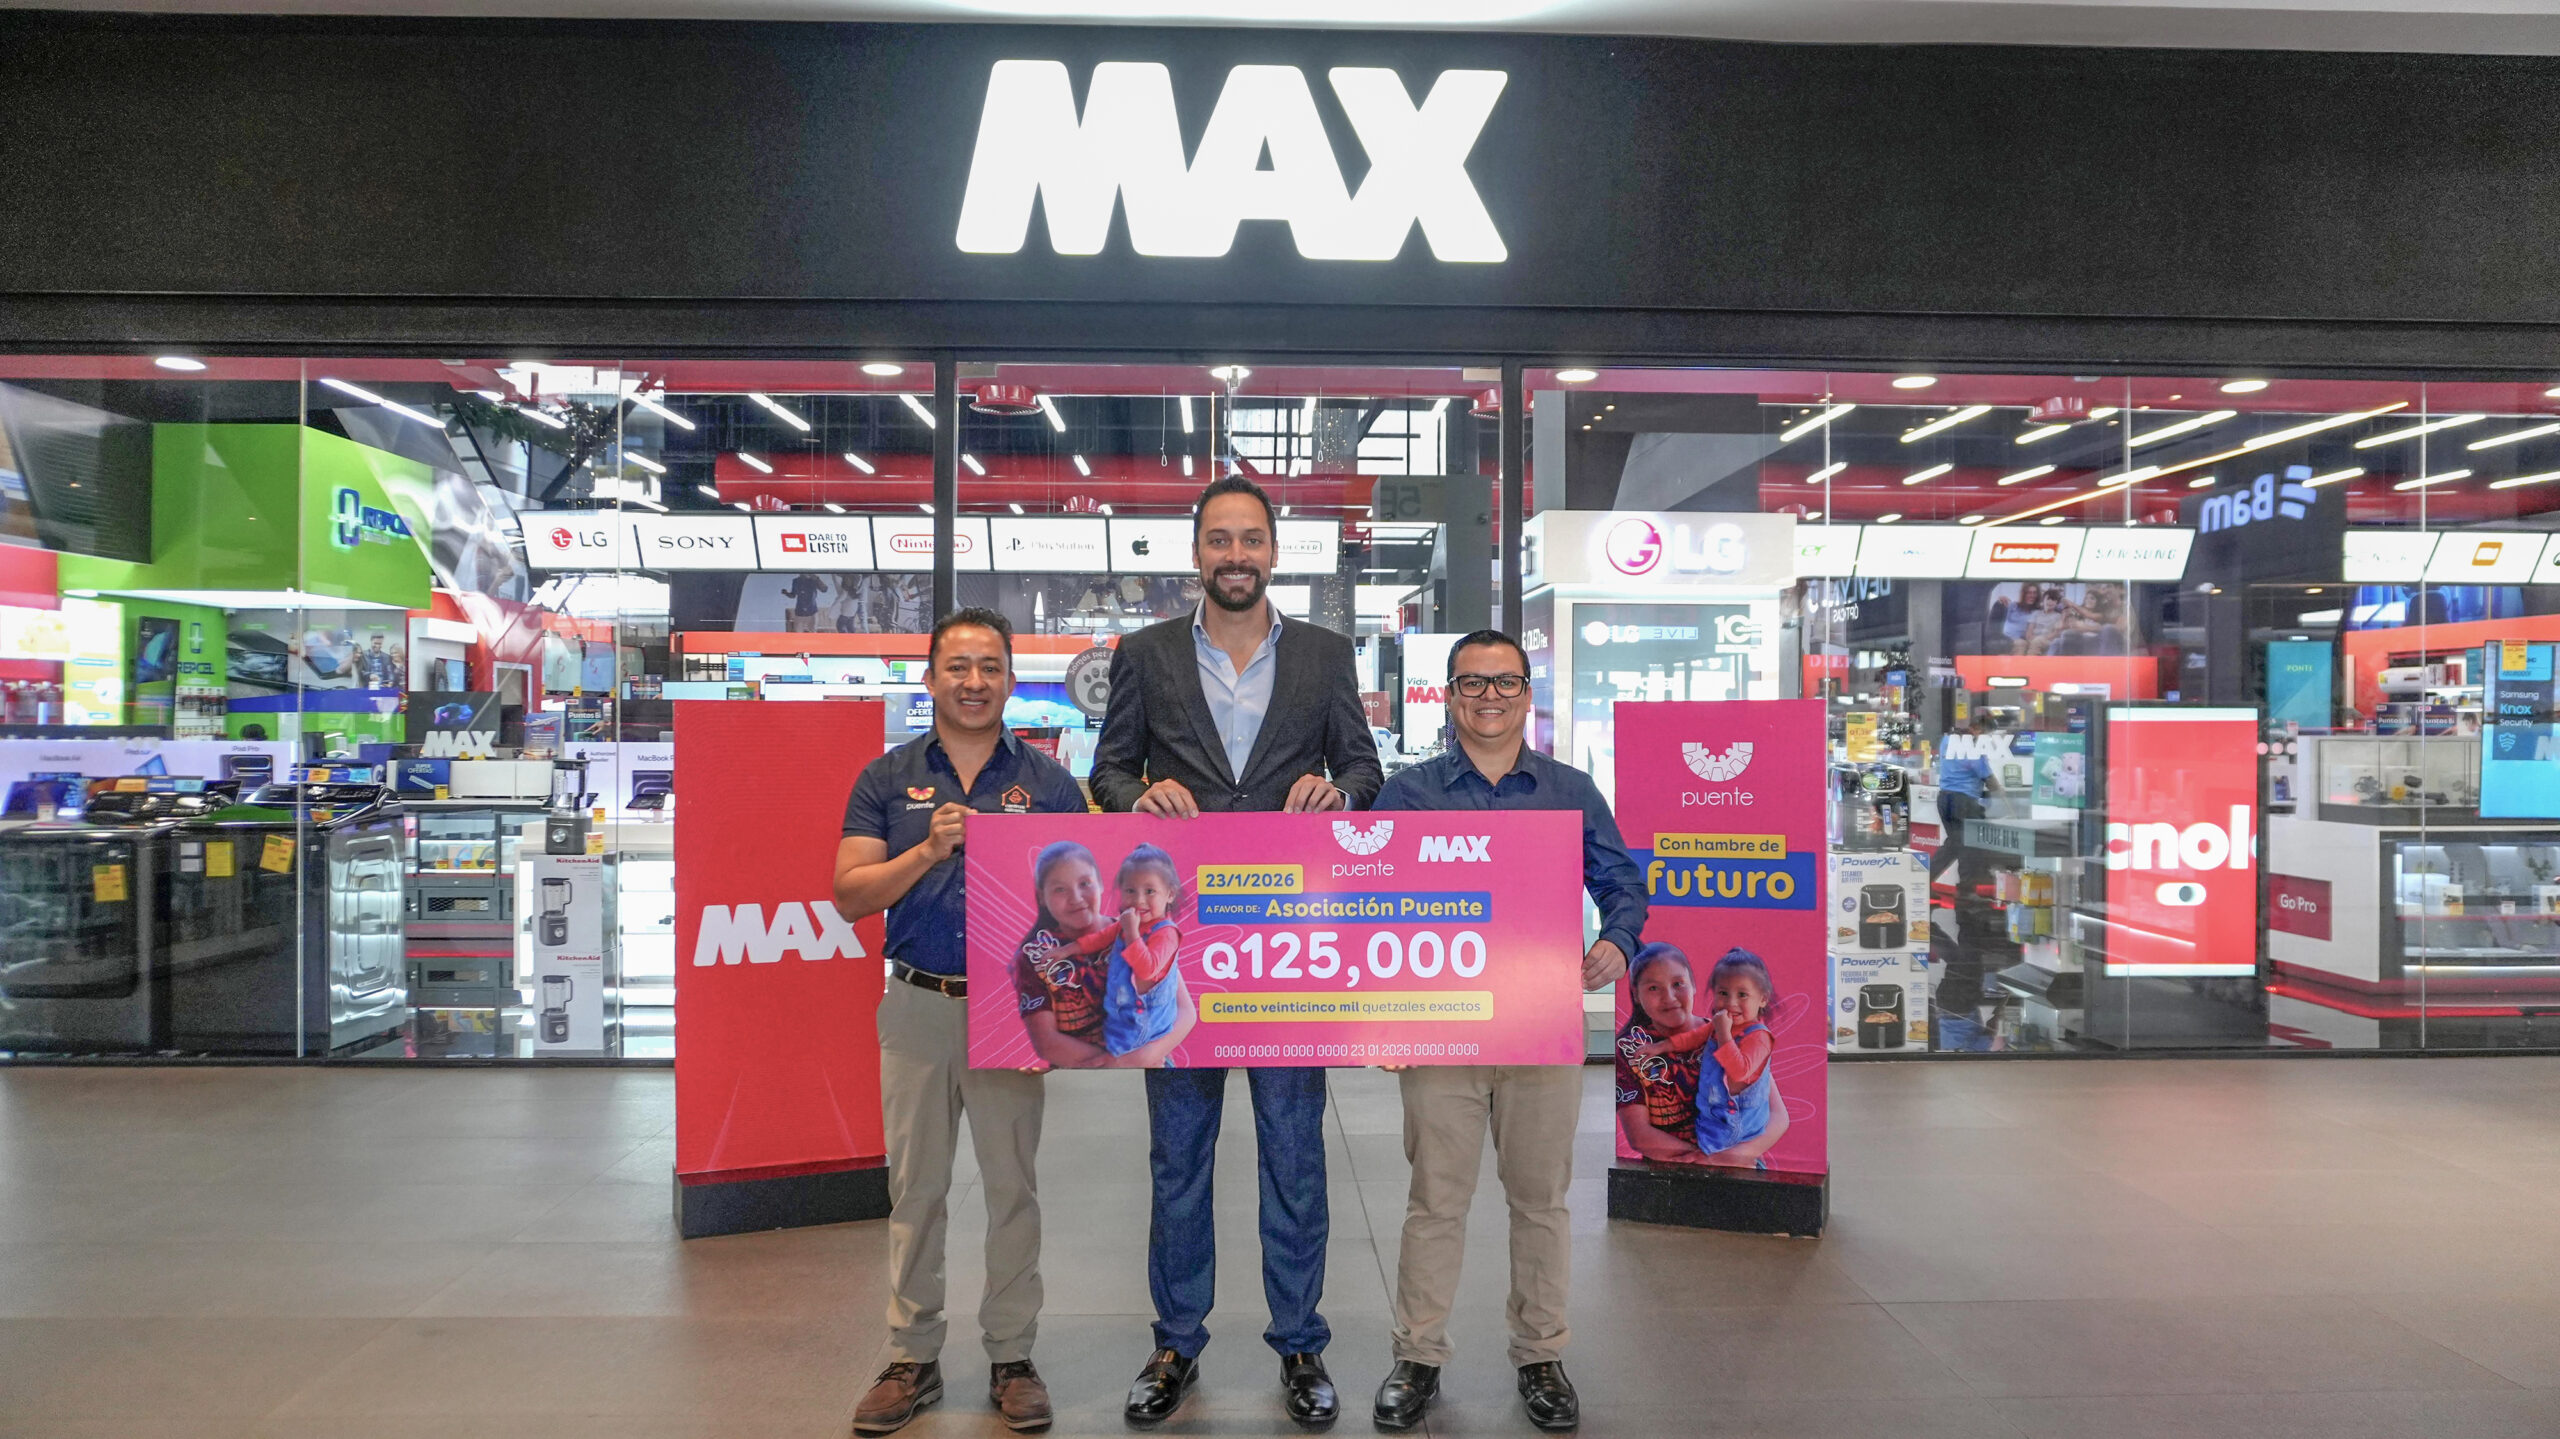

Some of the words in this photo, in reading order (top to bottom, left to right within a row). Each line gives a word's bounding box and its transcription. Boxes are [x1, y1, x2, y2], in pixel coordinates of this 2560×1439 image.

[956, 60, 1508, 262] MAX
[579, 531, 607, 547] LG
[658, 536, 734, 549] SONY
[808, 533, 834, 541] DARE
[835, 533, 847, 541] TO
[809, 542, 849, 553] LISTEN
[1673, 522, 1746, 575] LG
[1611, 624, 1641, 643] LG
[1092, 650, 1107, 660] pet
[1407, 678, 1428, 686] Vida
[2500, 690, 2540, 701] Samsung
[2500, 703, 2533, 715] Knox
[2499, 719, 2534, 728] Security
[420, 731, 497, 758] MAX
[1945, 734, 2015, 760] MAX
[1682, 786, 1754, 807] puente
[906, 801, 935, 811] puente
[1418, 835, 1492, 863] MAX
[1660, 837, 1690, 850] Con
[1695, 838, 1755, 852] hambre
[1759, 839, 1780, 852] de
[1332, 859, 1395, 878] puente
[1841, 857, 1901, 868] PowerXL
[1205, 873, 1295, 887] 23/1/2026
[1647, 860, 1795, 900] futuro
[1205, 906, 1212, 914] A
[1213, 905, 1244, 914] FAVOR
[1246, 905, 1261, 914] DE:
[1265, 897, 1394, 917] Asociación
[1401, 897, 1483, 917] Puente
[2280, 894, 2296, 910] Go
[2298, 897, 2317, 913] Pro
[693, 900, 867, 967] MAX
[1202, 930, 1487, 988] Q125,000
[1840, 957, 1900, 968] PowerXL
[1212, 1002, 1257, 1013] Ciento
[1260, 1001, 1336, 1013] veinticinco
[1340, 1001, 1359, 1013] mil
[1362, 1001, 1425, 1014] quetzales
[1429, 1001, 1481, 1013] exactos
[1214, 1045, 1245, 1057] 0000
[1248, 1045, 1280, 1057] 0000
[1283, 1045, 1314, 1057] 0000
[1317, 1044, 1348, 1057] 0000
[1351, 1044, 1365, 1056] 23
[1368, 1044, 1380, 1056] 01
[1382, 1044, 1411, 1056] 2026
[1414, 1043, 1445, 1056] 0000
[1448, 1043, 1479, 1055] 0000
